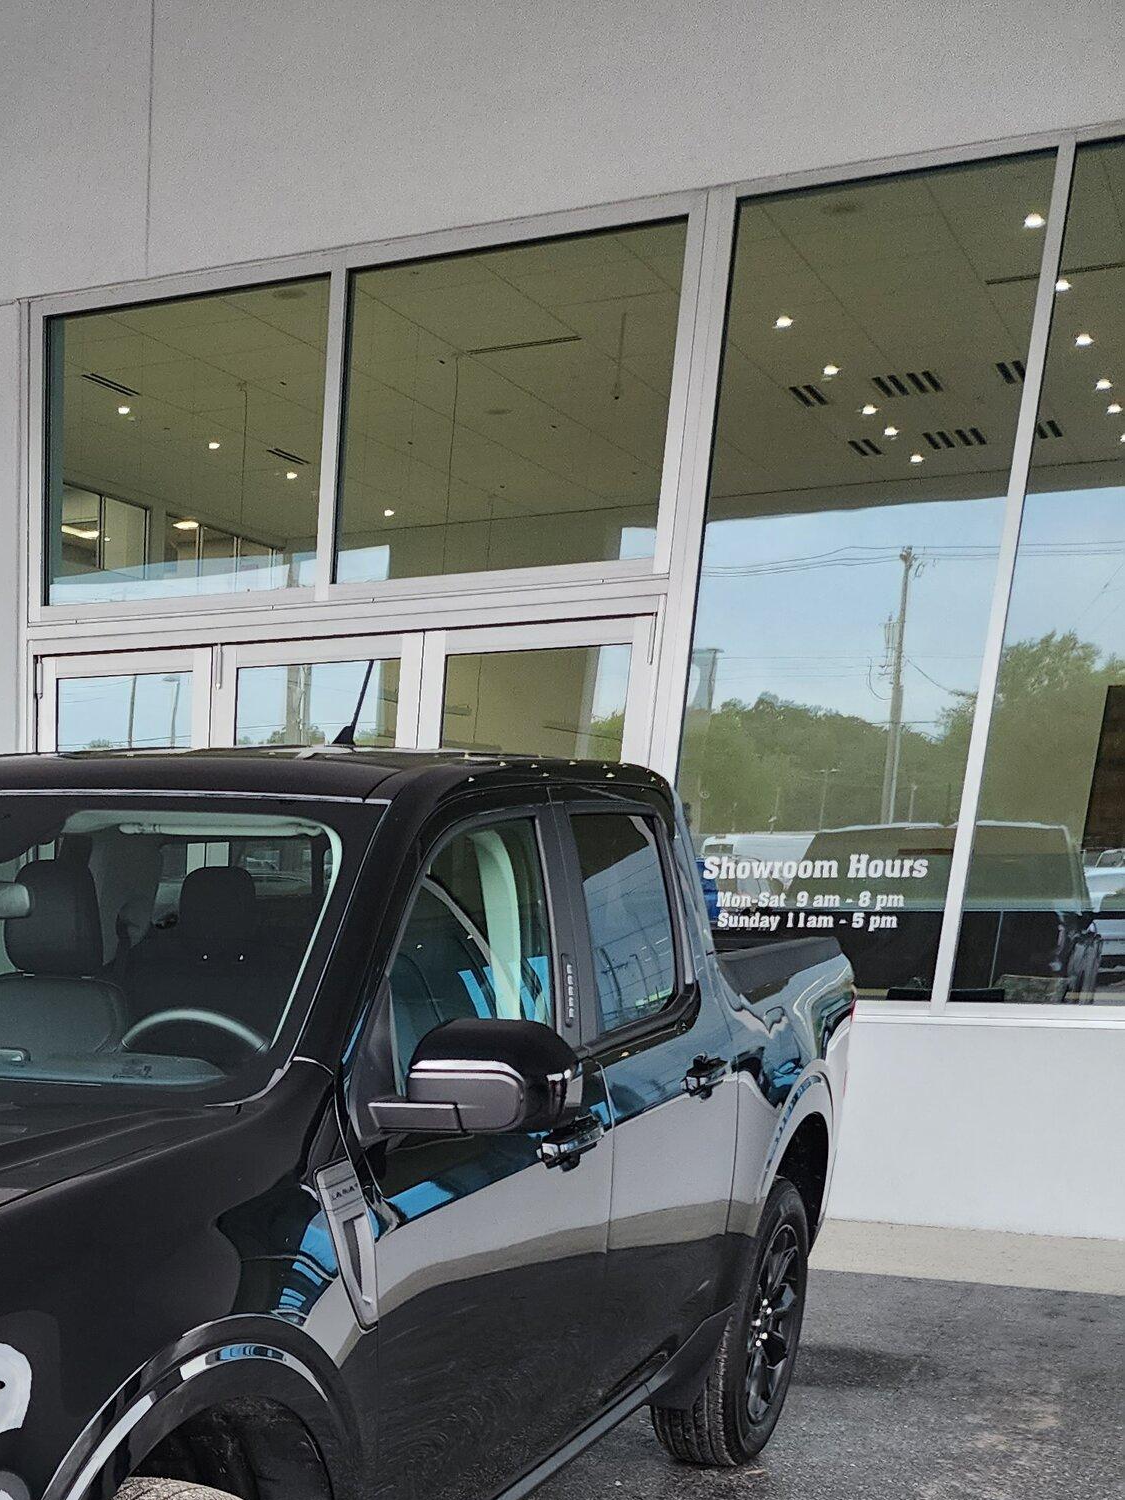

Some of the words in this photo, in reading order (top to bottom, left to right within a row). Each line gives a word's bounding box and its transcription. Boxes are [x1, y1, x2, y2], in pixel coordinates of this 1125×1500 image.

[703, 856, 838, 879] Showroom
[847, 854, 929, 878] Hours
[716, 891, 786, 908] Mon-Sat
[796, 891, 809, 907] 9
[813, 894, 839, 907] am
[858, 891, 871, 907] 8
[875, 893, 905, 911] pm
[717, 912, 780, 931] Sunday
[852, 912, 865, 928] 5
[868, 914, 898, 931] pm
